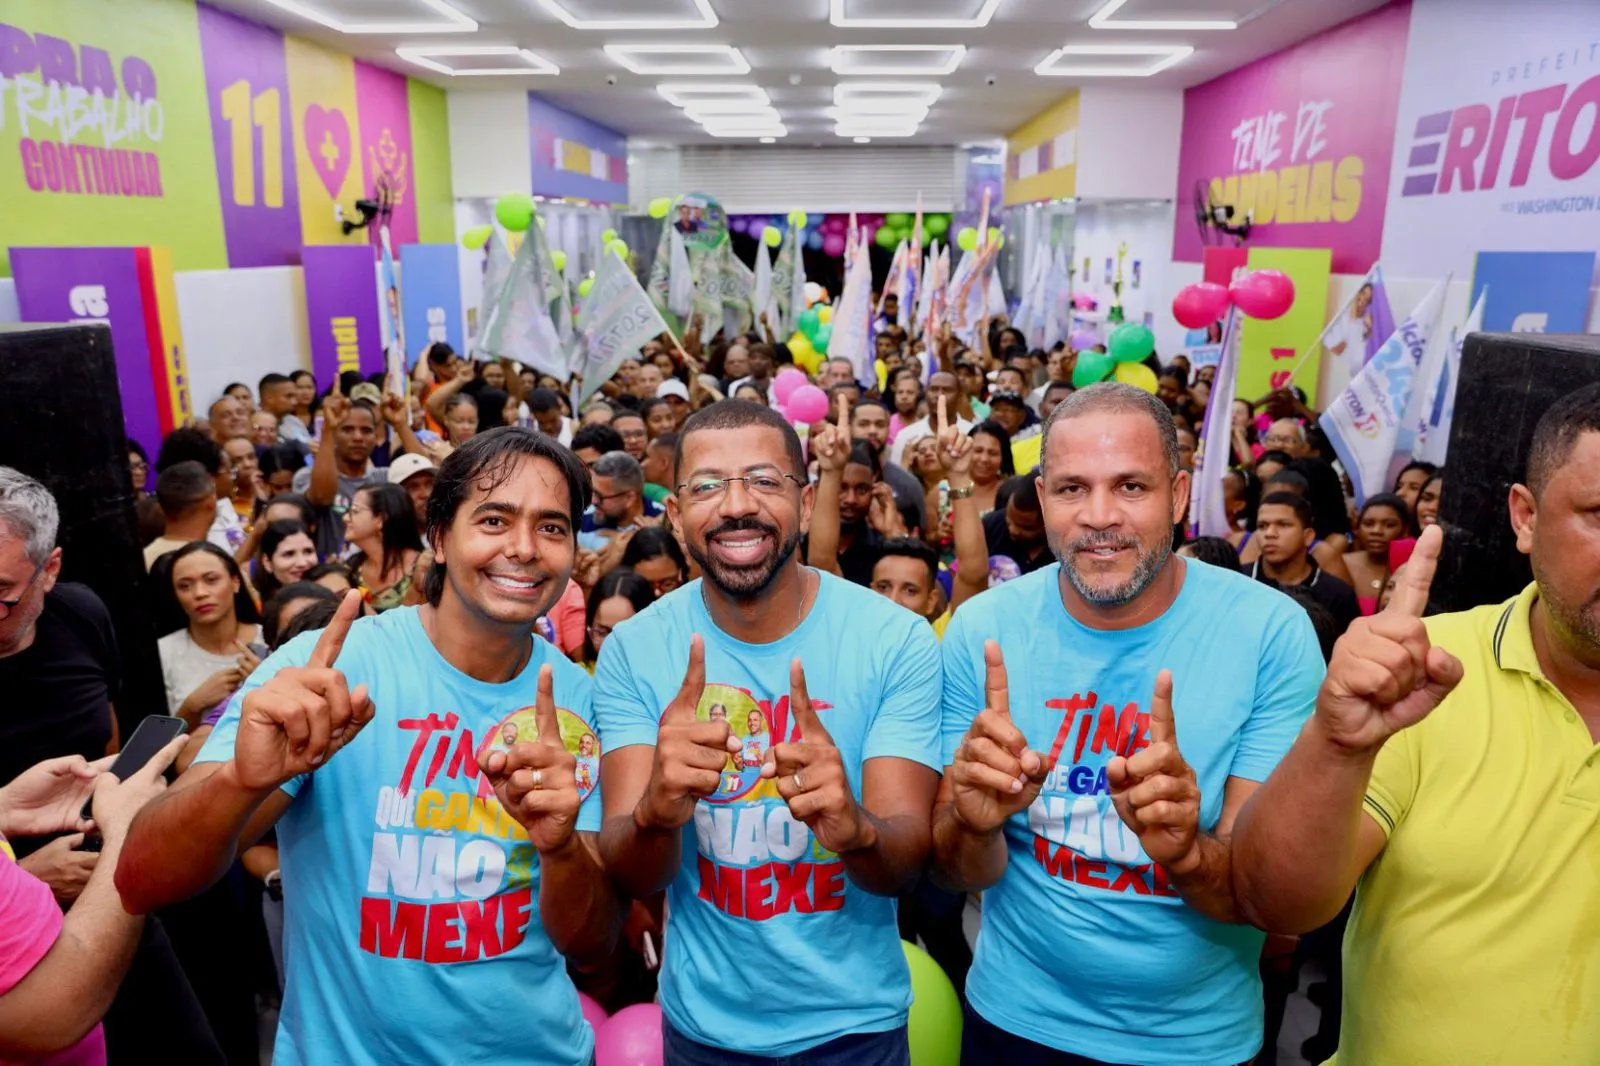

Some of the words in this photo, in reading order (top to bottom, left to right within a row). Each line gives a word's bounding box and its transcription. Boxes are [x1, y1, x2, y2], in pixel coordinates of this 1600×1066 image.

[20, 137, 163, 197] CONTINUAR
[221, 79, 283, 208] 11
[375, 785, 417, 829] QUE
[693, 800, 808, 864] NÃO
[367, 829, 506, 900] NÃO
[697, 853, 846, 921] MEXE
[359, 888, 532, 964] MEXE
